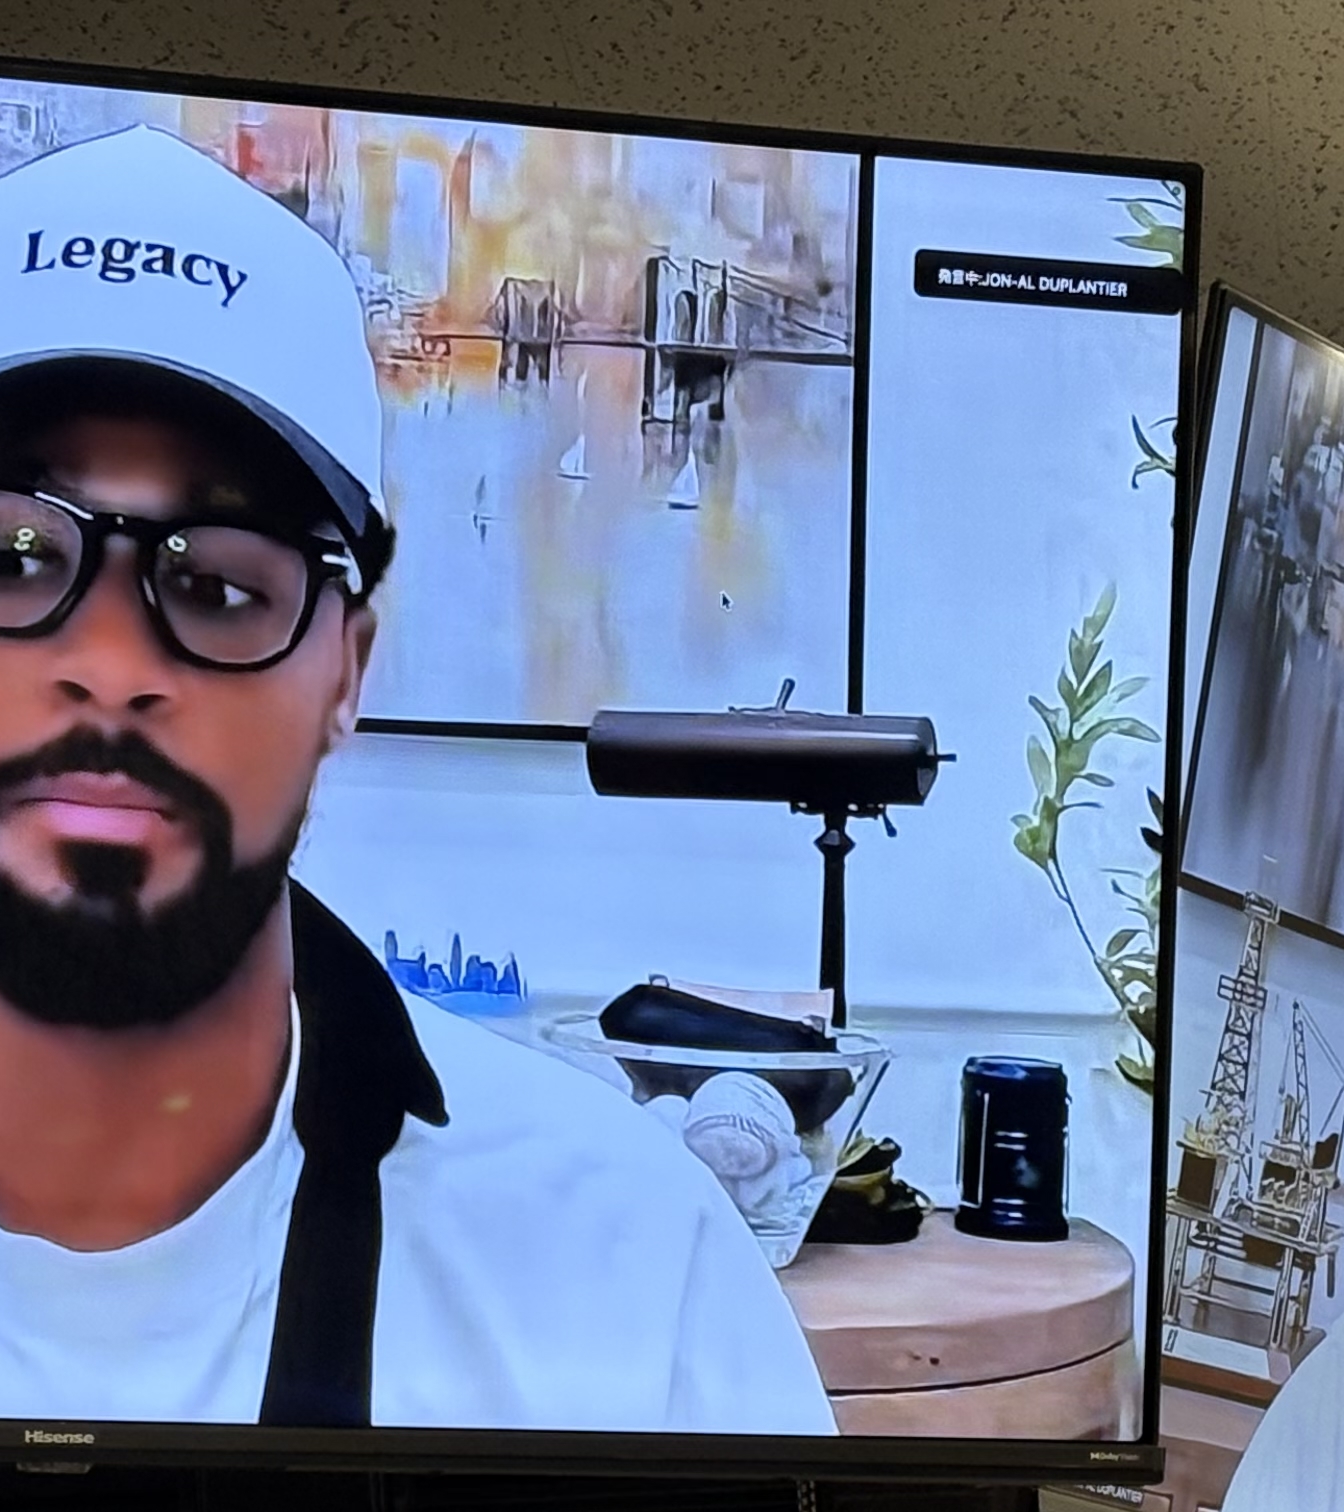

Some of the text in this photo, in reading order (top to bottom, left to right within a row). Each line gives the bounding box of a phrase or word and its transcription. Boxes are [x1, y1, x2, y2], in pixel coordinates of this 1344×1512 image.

[20, 229, 249, 308] Legacy
[1039, 275, 1129, 298] DUPLANTIER
[24, 1429, 96, 1445] Hisense
